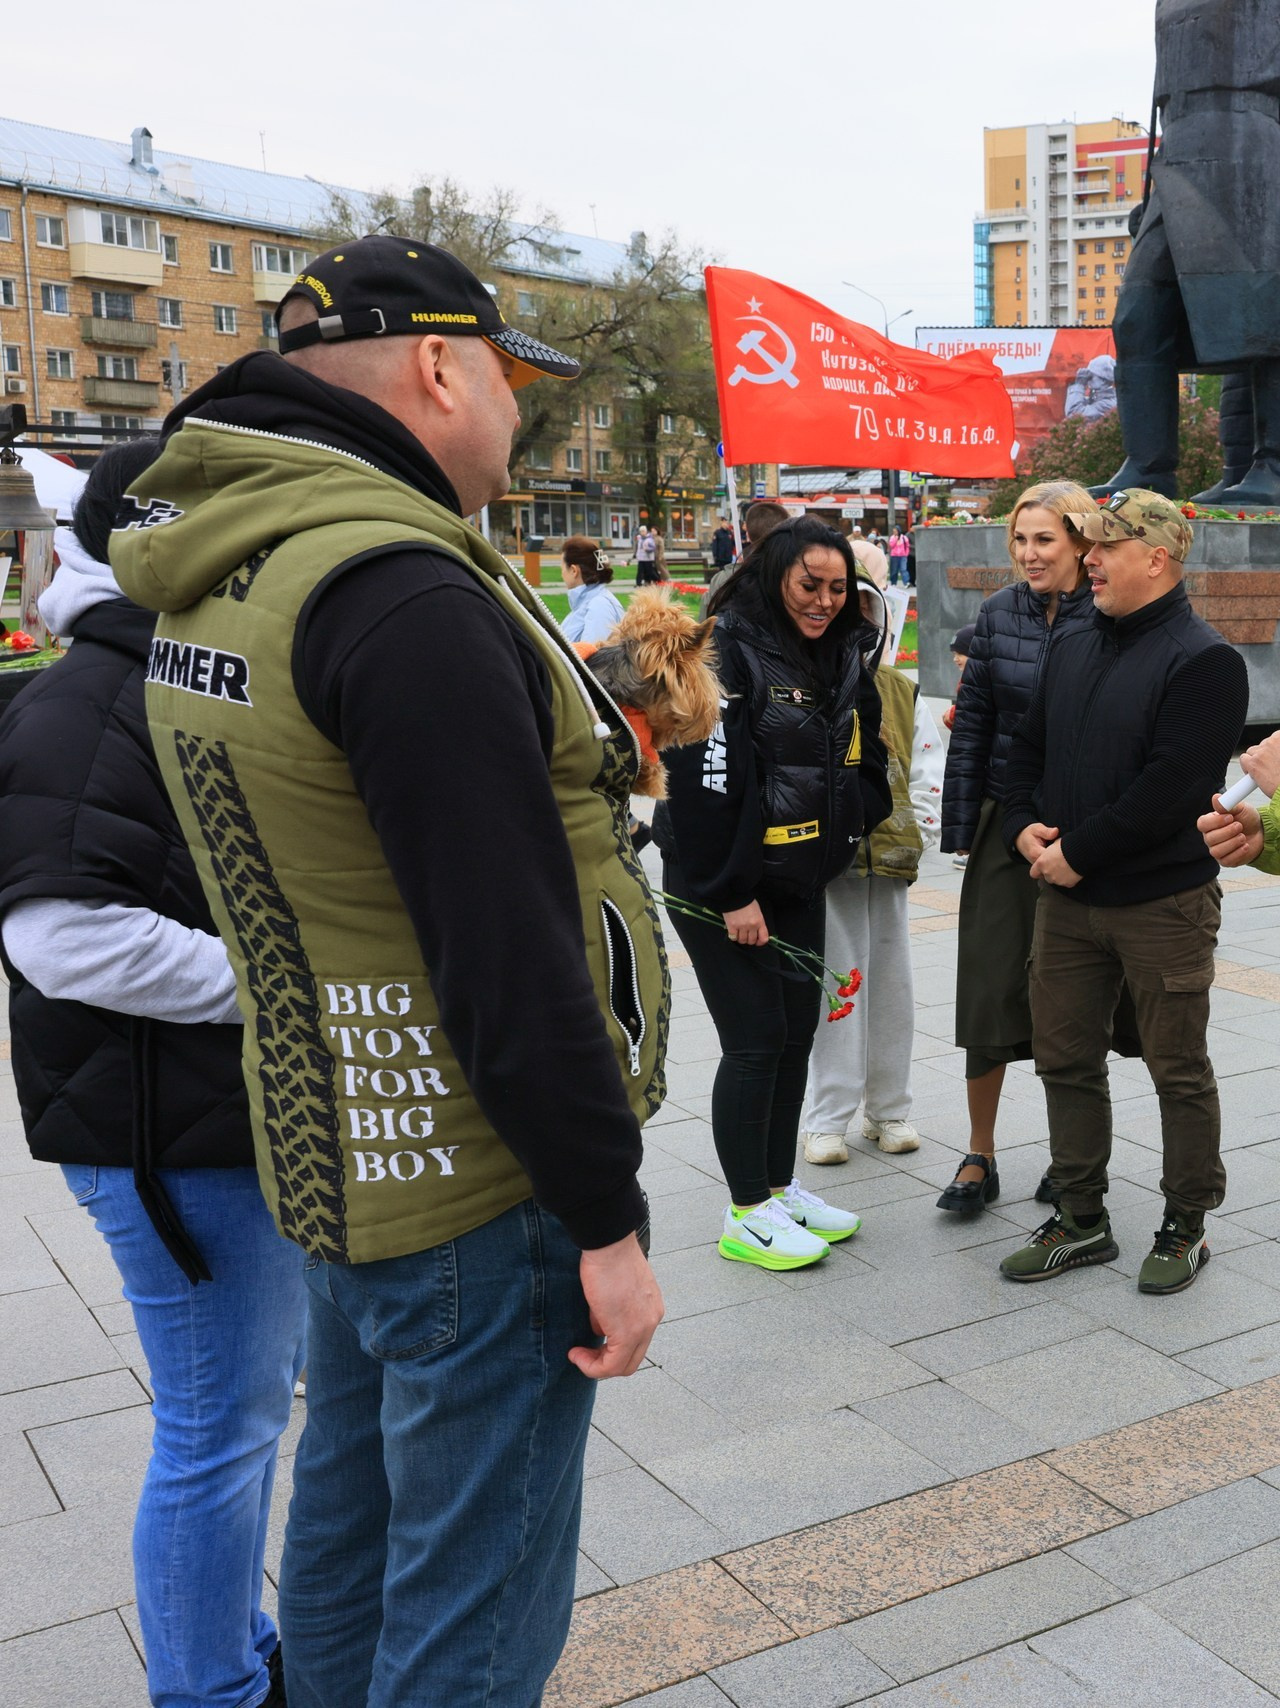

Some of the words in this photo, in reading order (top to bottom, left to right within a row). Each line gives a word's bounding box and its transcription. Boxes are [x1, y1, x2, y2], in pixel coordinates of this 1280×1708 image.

[304, 275, 334, 309] FREEDOM
[411, 312, 478, 325] HUMMER
[810, 321, 834, 343] 150
[849, 404, 880, 441] 79
[325, 983, 413, 1016] BIG
[329, 1026, 437, 1059] TOY
[344, 1065, 450, 1098] FOR
[347, 1106, 435, 1140] BIG
[353, 1145, 461, 1182] BOY
